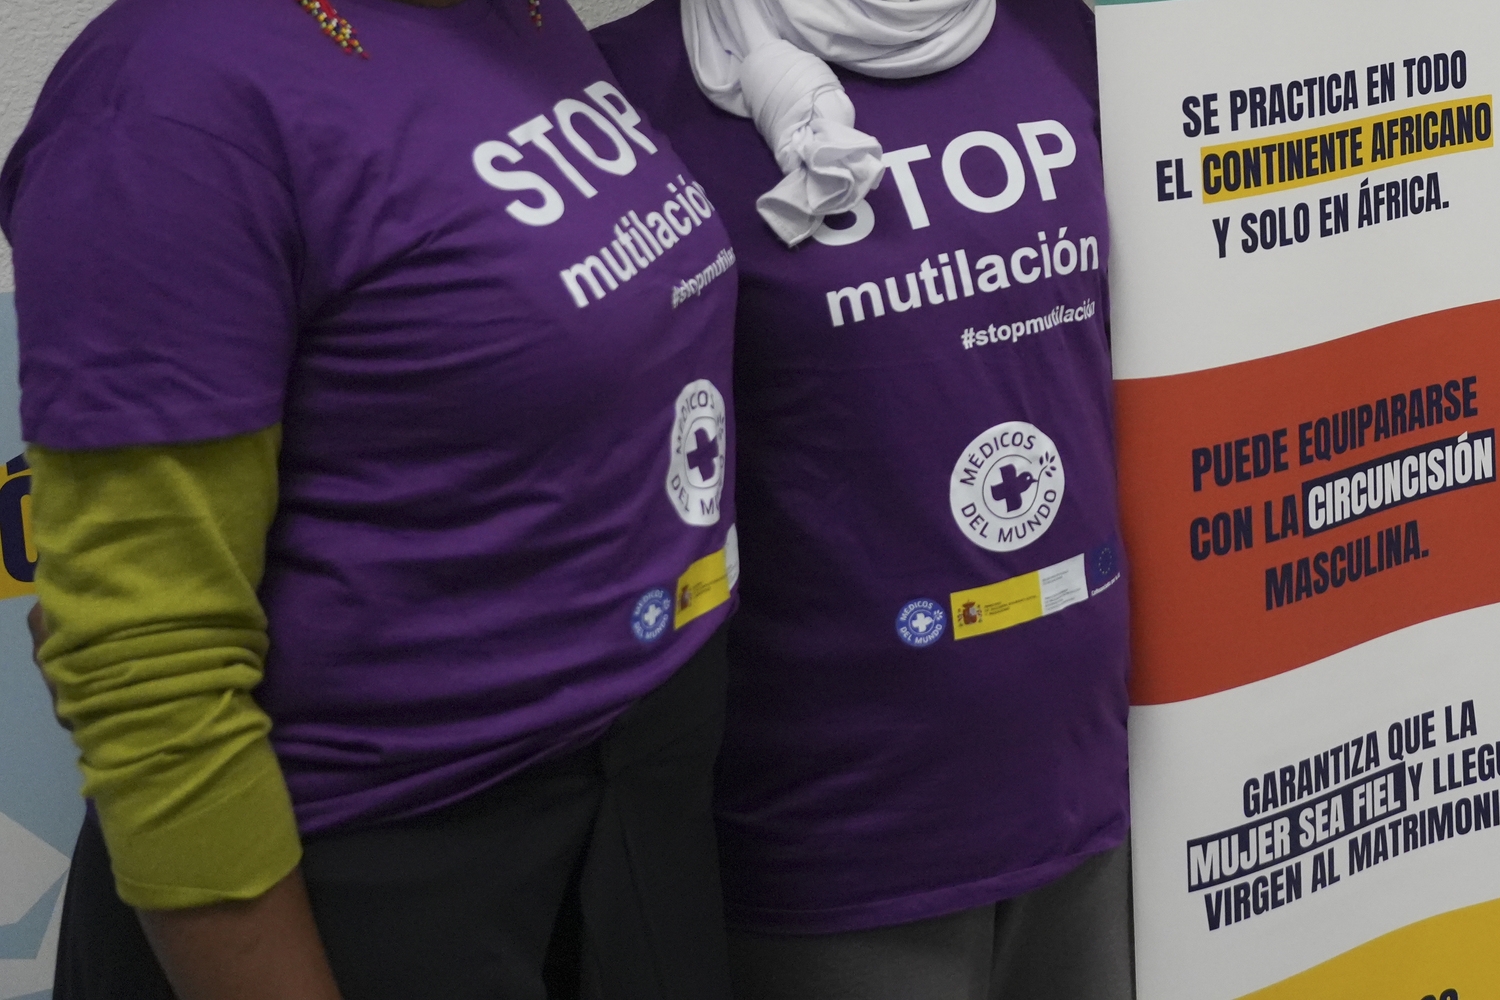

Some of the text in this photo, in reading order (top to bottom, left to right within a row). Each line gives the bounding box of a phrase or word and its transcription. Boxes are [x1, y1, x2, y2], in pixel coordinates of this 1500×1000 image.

[1181, 50, 1467, 137] SE PRACTICA EN TODO
[472, 80, 658, 226] STOP
[1156, 102, 1492, 202] EL CONTINENTE AFRICANO
[1212, 171, 1449, 258] Y SOLO EN ÁFRICA.
[826, 227, 1098, 328] mutilación
[961, 298, 1095, 349] #stopmutilación
[960, 431, 1036, 486] MÉDICOS
[1192, 376, 1477, 492] PUEDE EQUIPARARSE
[961, 489, 1056, 543] DEL MUNDO
[1189, 431, 1493, 561] CON LA CIRCUNCISIÓN
[1265, 520, 1429, 611] MASCULINA.
[900, 624, 942, 643] DEL MUNDO
[1243, 700, 1477, 817] GARANTIZA QUE LA
[1190, 817, 1290, 887] MUJER
[1299, 796, 1345, 848] SEA
[1353, 774, 1400, 825] FIEL
[1407, 762, 1423, 802] Y
[1204, 862, 1301, 931] VIRGEN
[1311, 846, 1340, 893] AL
